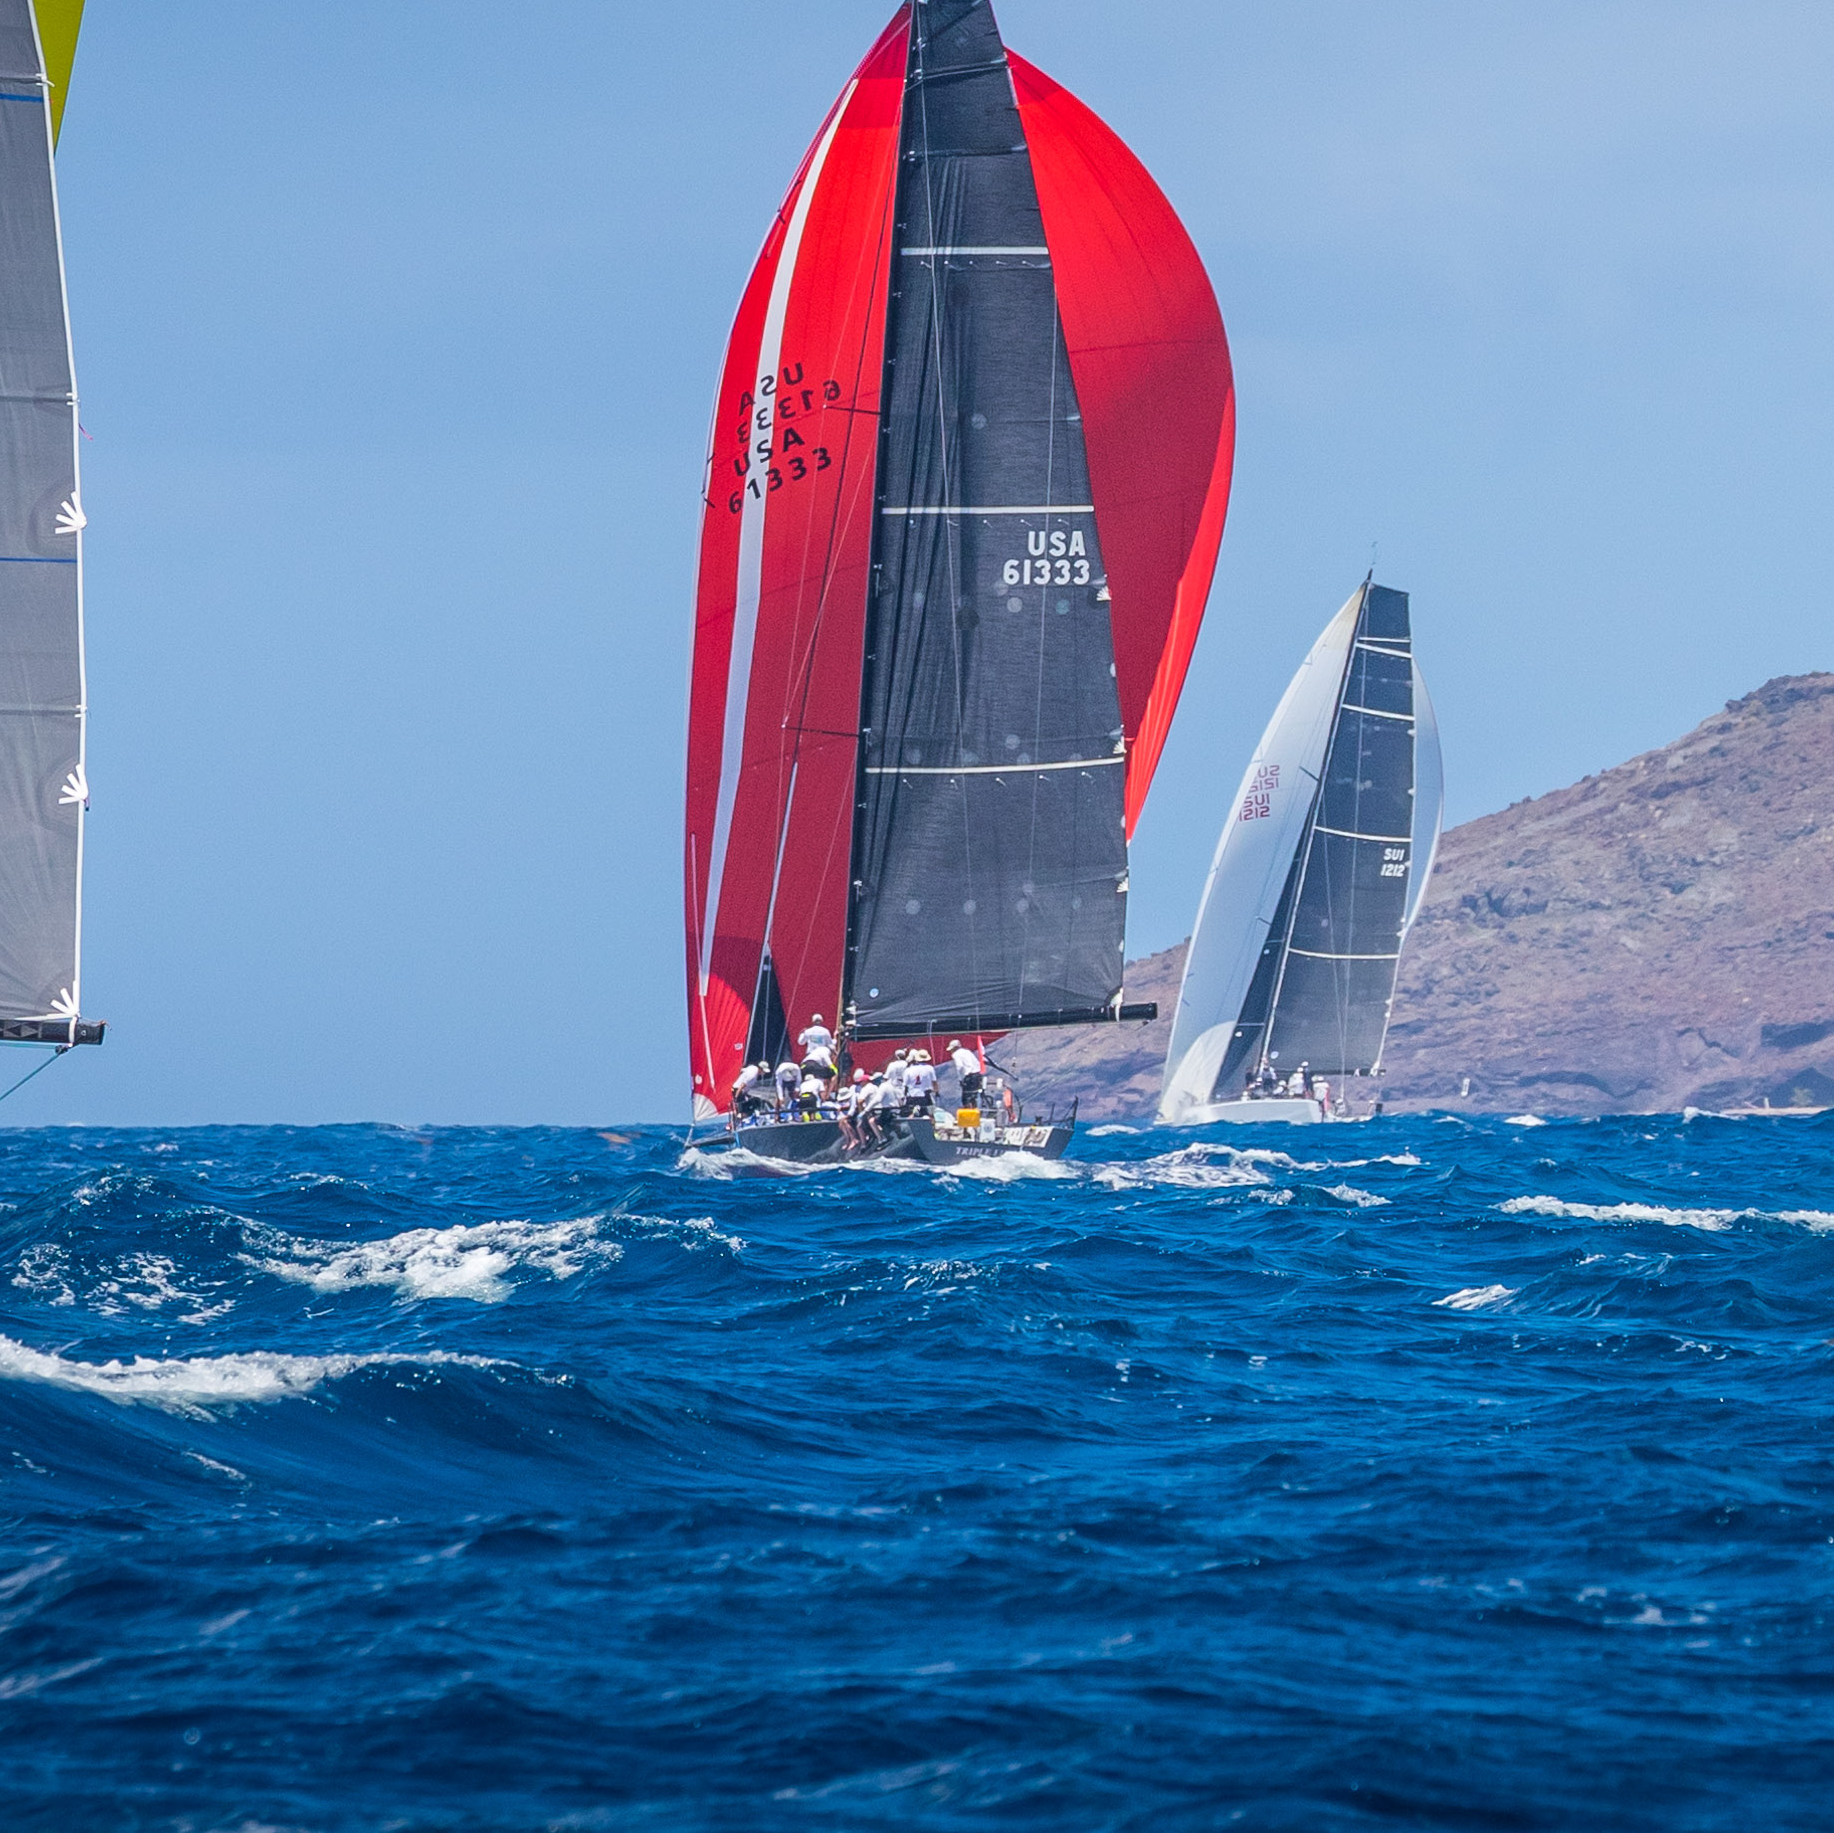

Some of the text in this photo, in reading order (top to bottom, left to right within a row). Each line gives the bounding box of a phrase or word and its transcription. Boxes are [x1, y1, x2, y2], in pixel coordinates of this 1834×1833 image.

[733, 426, 806, 478] USA
[728, 446, 833, 515] 61333
[1027, 530, 1086, 557] USA
[1002, 558, 1091, 586] 61333
[1243, 792, 1271, 809] SUI
[1238, 805, 1271, 822] 1212
[1383, 847, 1406, 862] SUI
[1380, 863, 1406, 878] 1212
